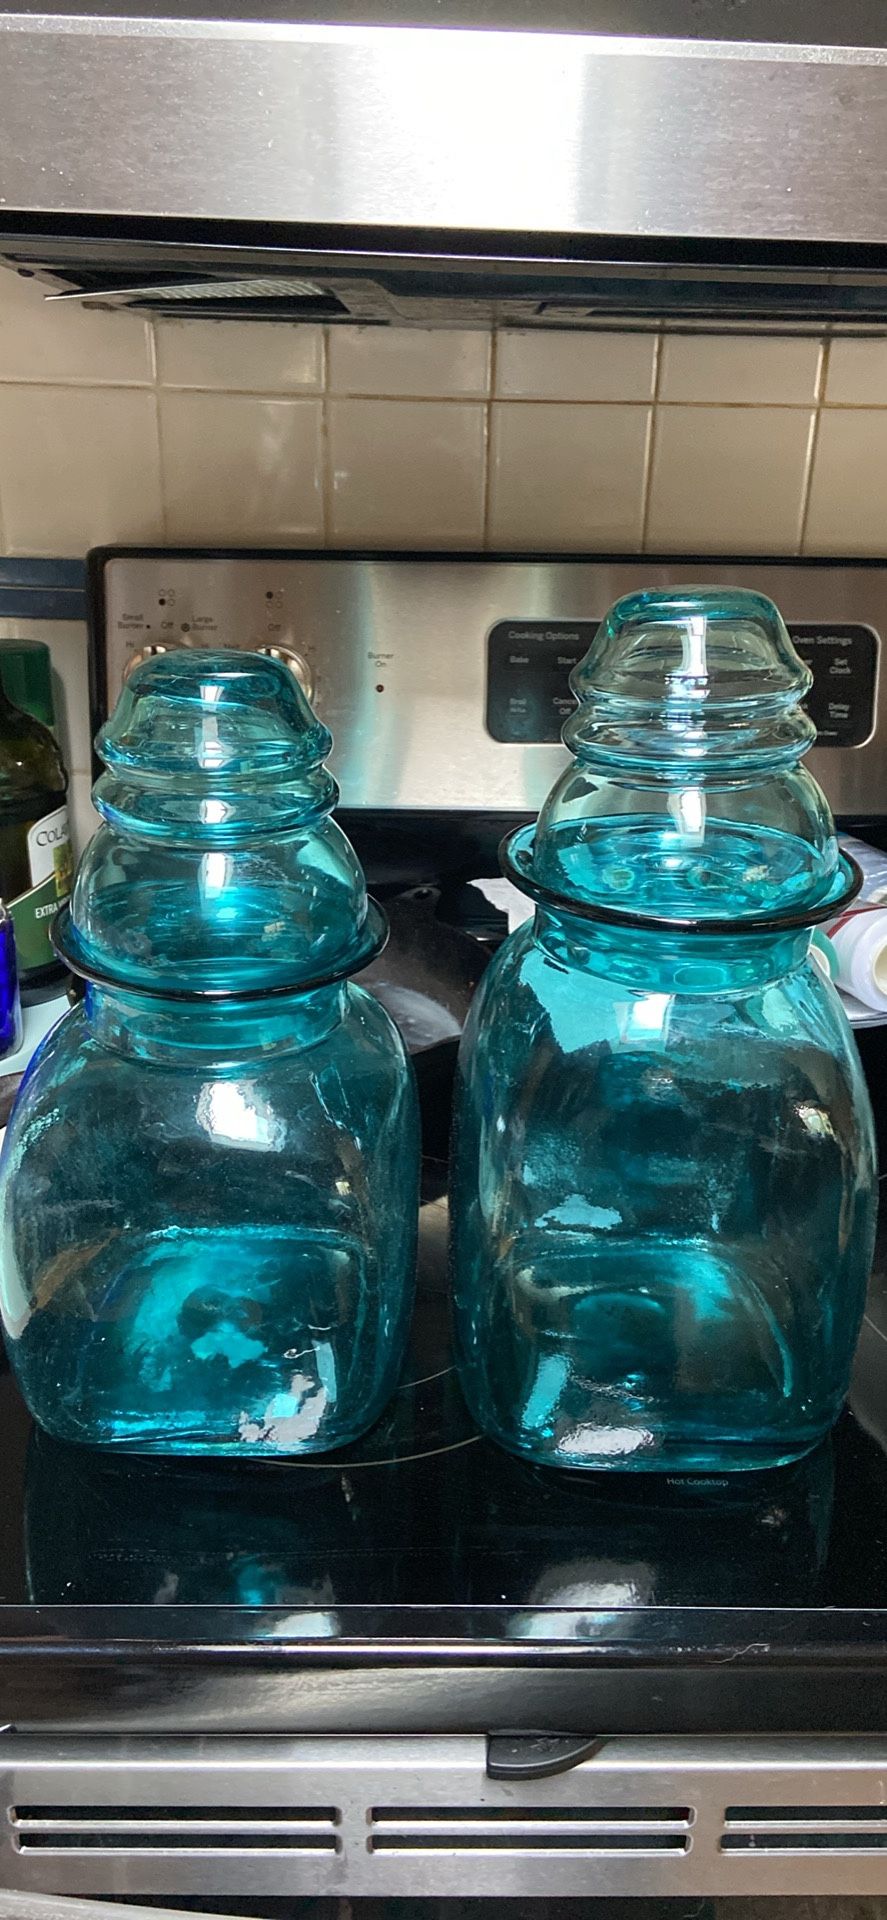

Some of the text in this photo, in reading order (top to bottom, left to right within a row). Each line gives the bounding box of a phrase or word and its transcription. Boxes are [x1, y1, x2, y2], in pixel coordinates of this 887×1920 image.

[122, 613, 144, 621] Small
[192, 615, 213, 623] Large
[117, 621, 144, 629] Burner
[161, 621, 174, 629] Off
[191, 623, 218, 631] Burner
[268, 623, 281, 631] Off
[509, 631, 579, 643] Cooking Options
[791, 635, 853, 647] Oven Settings
[367, 651, 394, 660] Burner
[509, 655, 530, 663] Bake
[375, 660, 387, 668] On
[557, 656, 577, 664] Start
[833, 658, 848, 666] Set
[829, 666, 852, 674] Clock
[828, 702, 850, 711] Delay
[558, 707, 572, 715] Off
[829, 710, 849, 719] Time
[35, 901, 59, 920] EXTRA
[666, 1477, 729, 1488] Hot Cooktop
